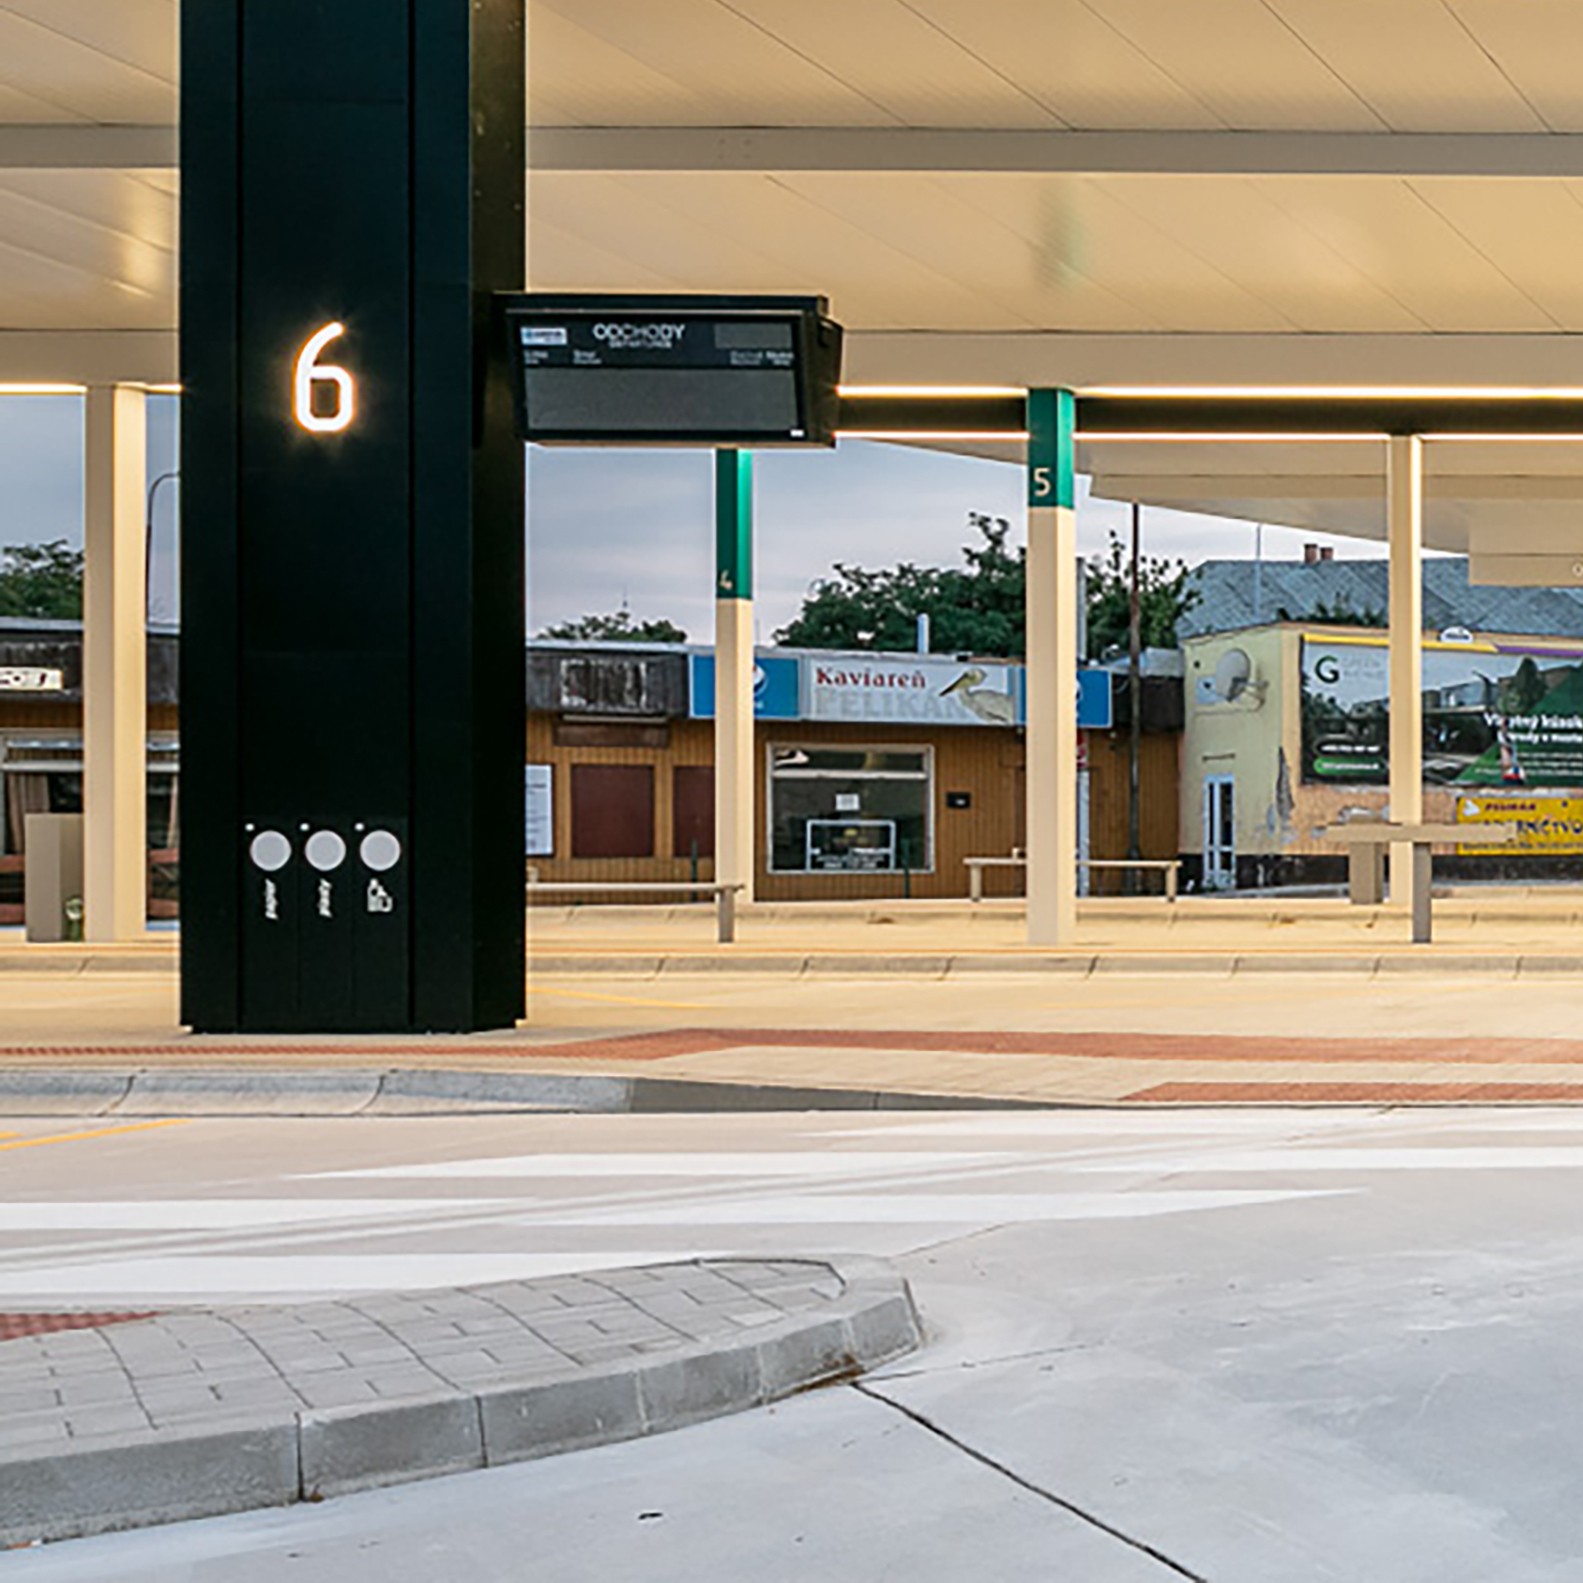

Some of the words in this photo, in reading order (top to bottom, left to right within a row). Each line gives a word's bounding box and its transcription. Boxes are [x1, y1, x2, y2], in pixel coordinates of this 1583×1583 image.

[293, 322, 355, 432] 6
[1034, 467, 1051, 497] 5
[815, 667, 926, 689] Kaviareň
[1315, 655, 1341, 684] G
